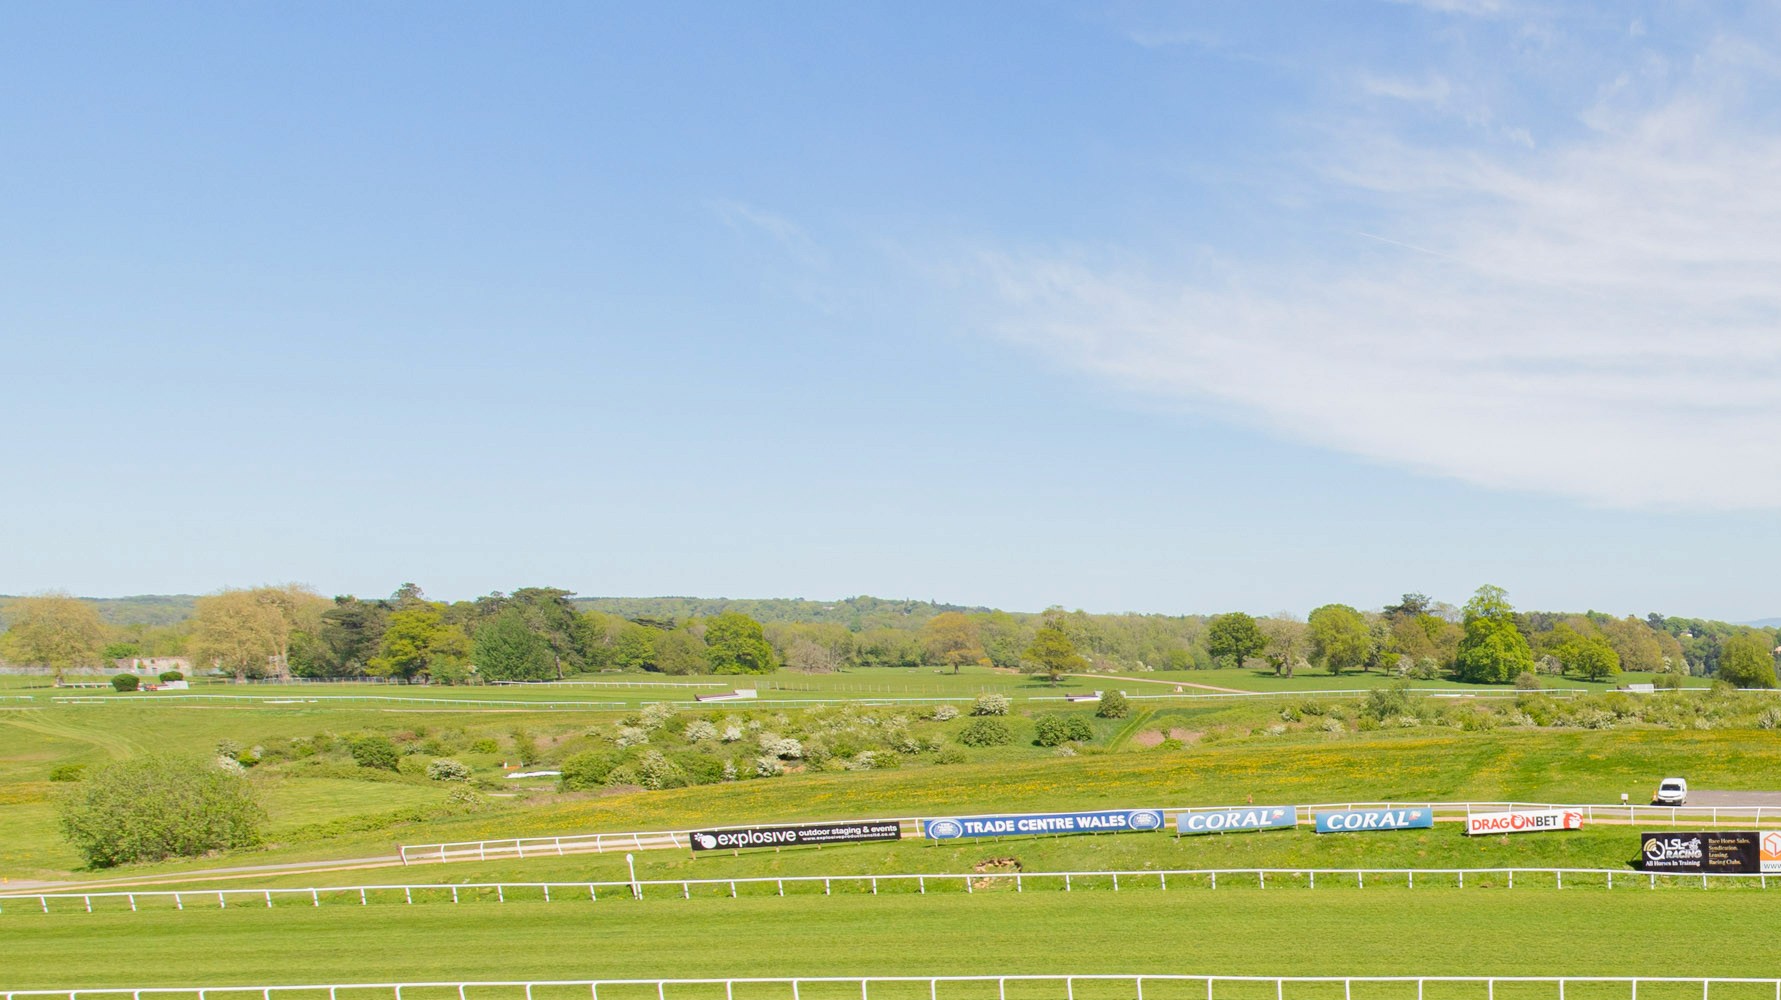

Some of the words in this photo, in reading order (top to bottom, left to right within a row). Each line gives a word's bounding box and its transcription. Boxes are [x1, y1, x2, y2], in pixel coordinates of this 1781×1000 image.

[965, 821, 1016, 833] TRADE
[1018, 818, 1074, 831] CENTRE
[1077, 815, 1126, 828] WALES
[1188, 811, 1272, 829] CORAL
[1327, 811, 1409, 829] CORAL
[1472, 815, 1557, 830] DRAGONBET
[717, 830, 797, 848] explosive
[798, 828, 830, 837] outdoor
[831, 826, 861, 836] staging
[862, 826, 869, 834] &
[871, 825, 897, 833] events
[1664, 839, 1684, 849] LSL
[1666, 850, 1702, 859] RACING
